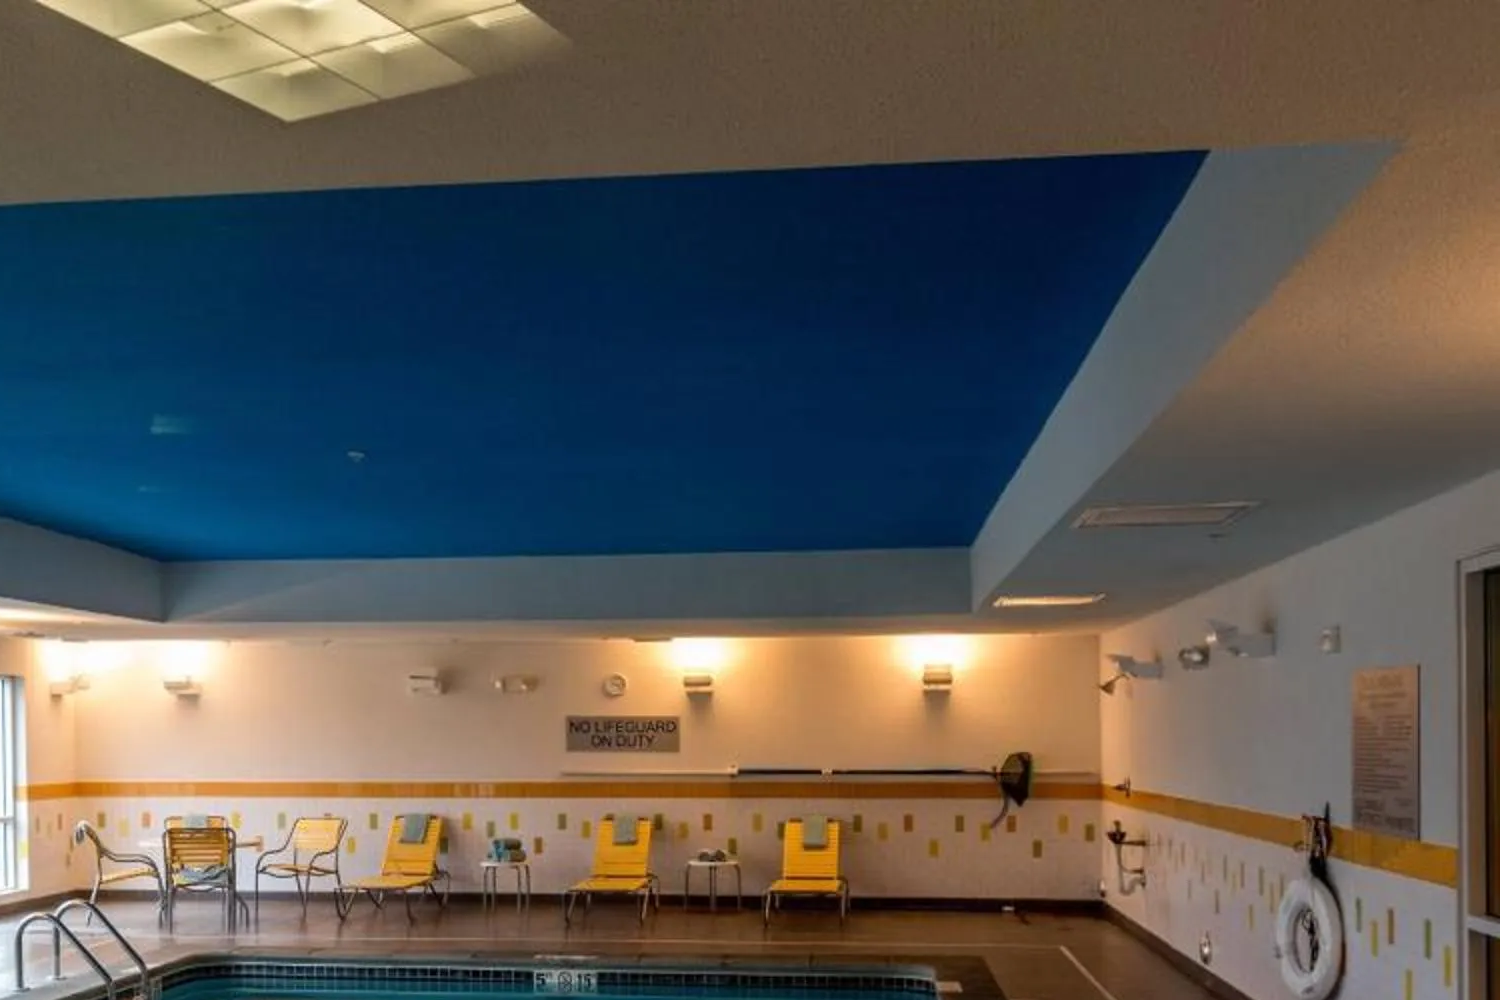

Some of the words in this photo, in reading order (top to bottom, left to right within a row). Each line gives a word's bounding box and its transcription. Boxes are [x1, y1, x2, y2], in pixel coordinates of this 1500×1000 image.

[569, 720, 591, 733] NO
[595, 720, 677, 733] LIFEGUARD
[591, 735, 612, 747] ON
[615, 735, 655, 748] DUTY
